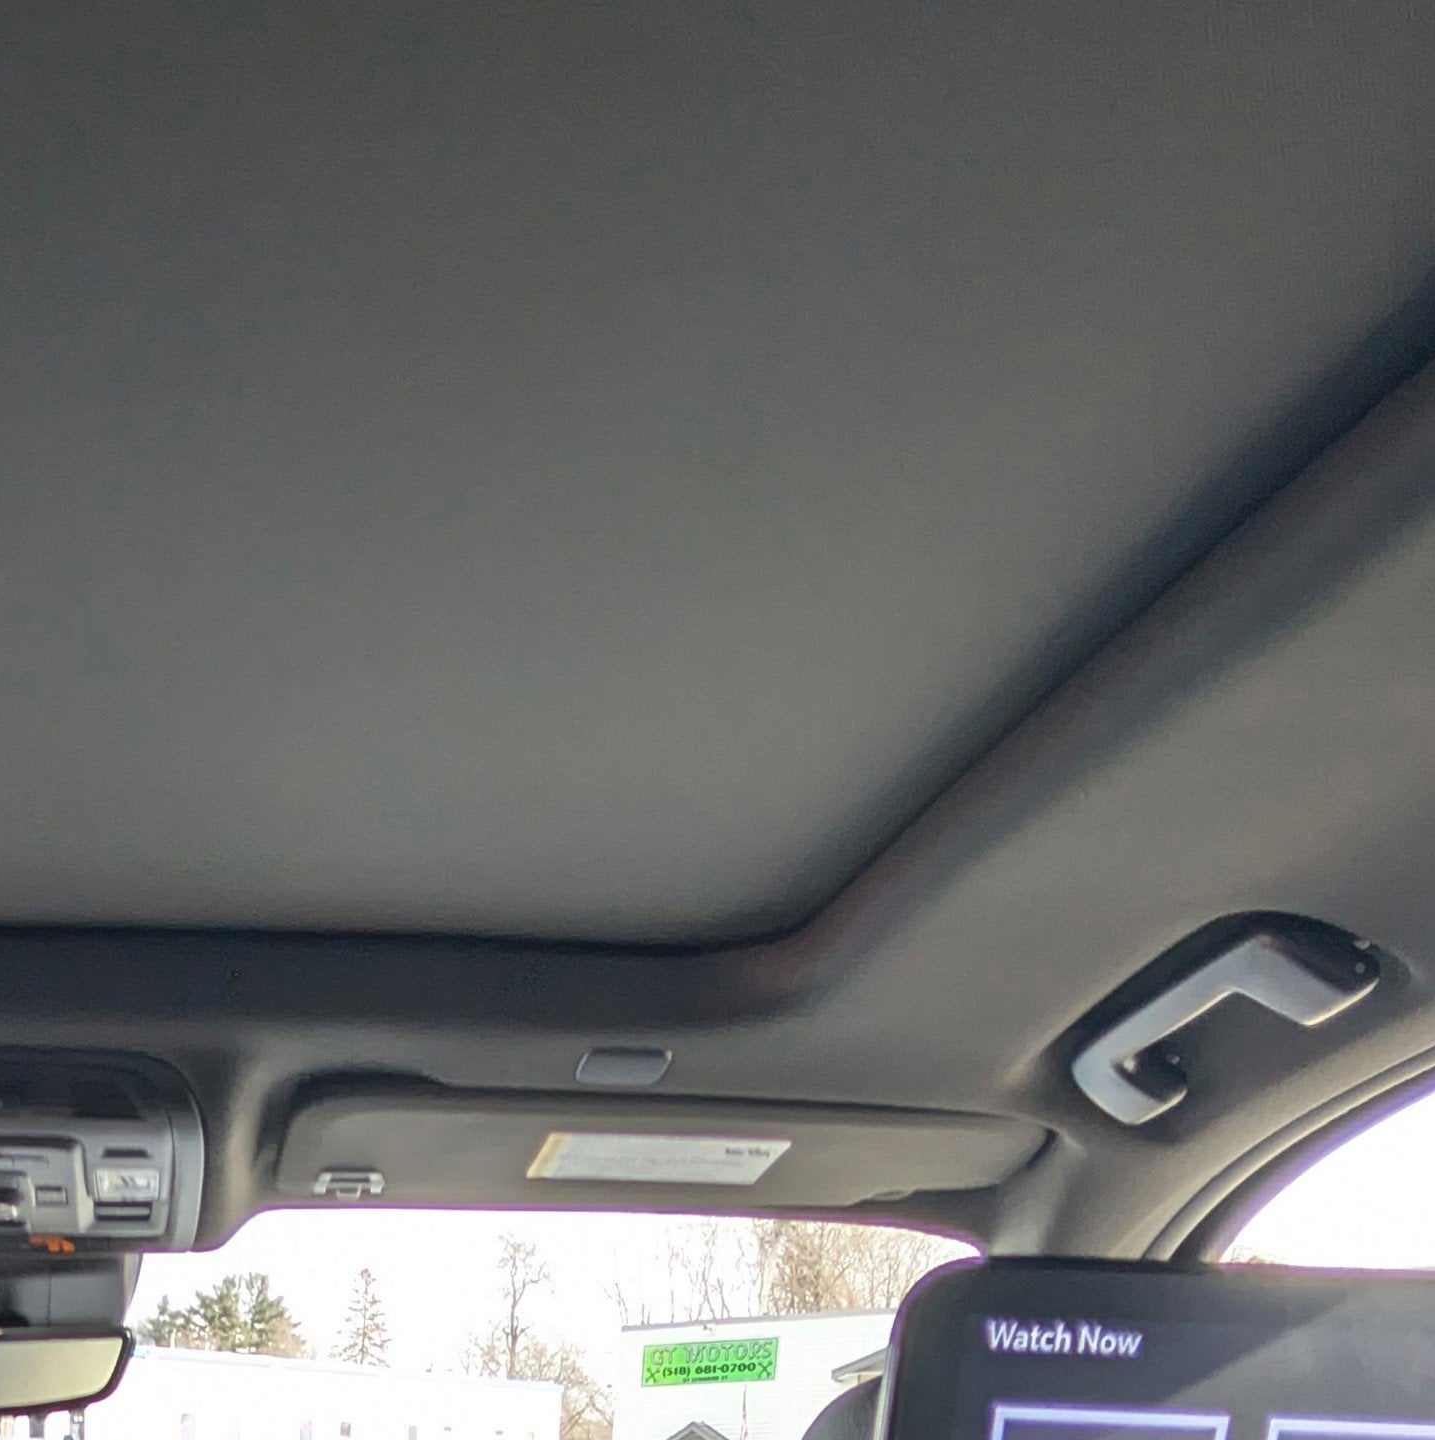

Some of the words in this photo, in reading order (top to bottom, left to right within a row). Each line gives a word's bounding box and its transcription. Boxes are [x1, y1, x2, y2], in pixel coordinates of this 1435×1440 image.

[987, 1319, 1071, 1353] Watch
[1077, 1323, 1143, 1357] Now
[684, 1340, 773, 1363] MOTORS
[662, 1366, 691, 1378] (518)
[695, 1361, 757, 1375] 681-0700
